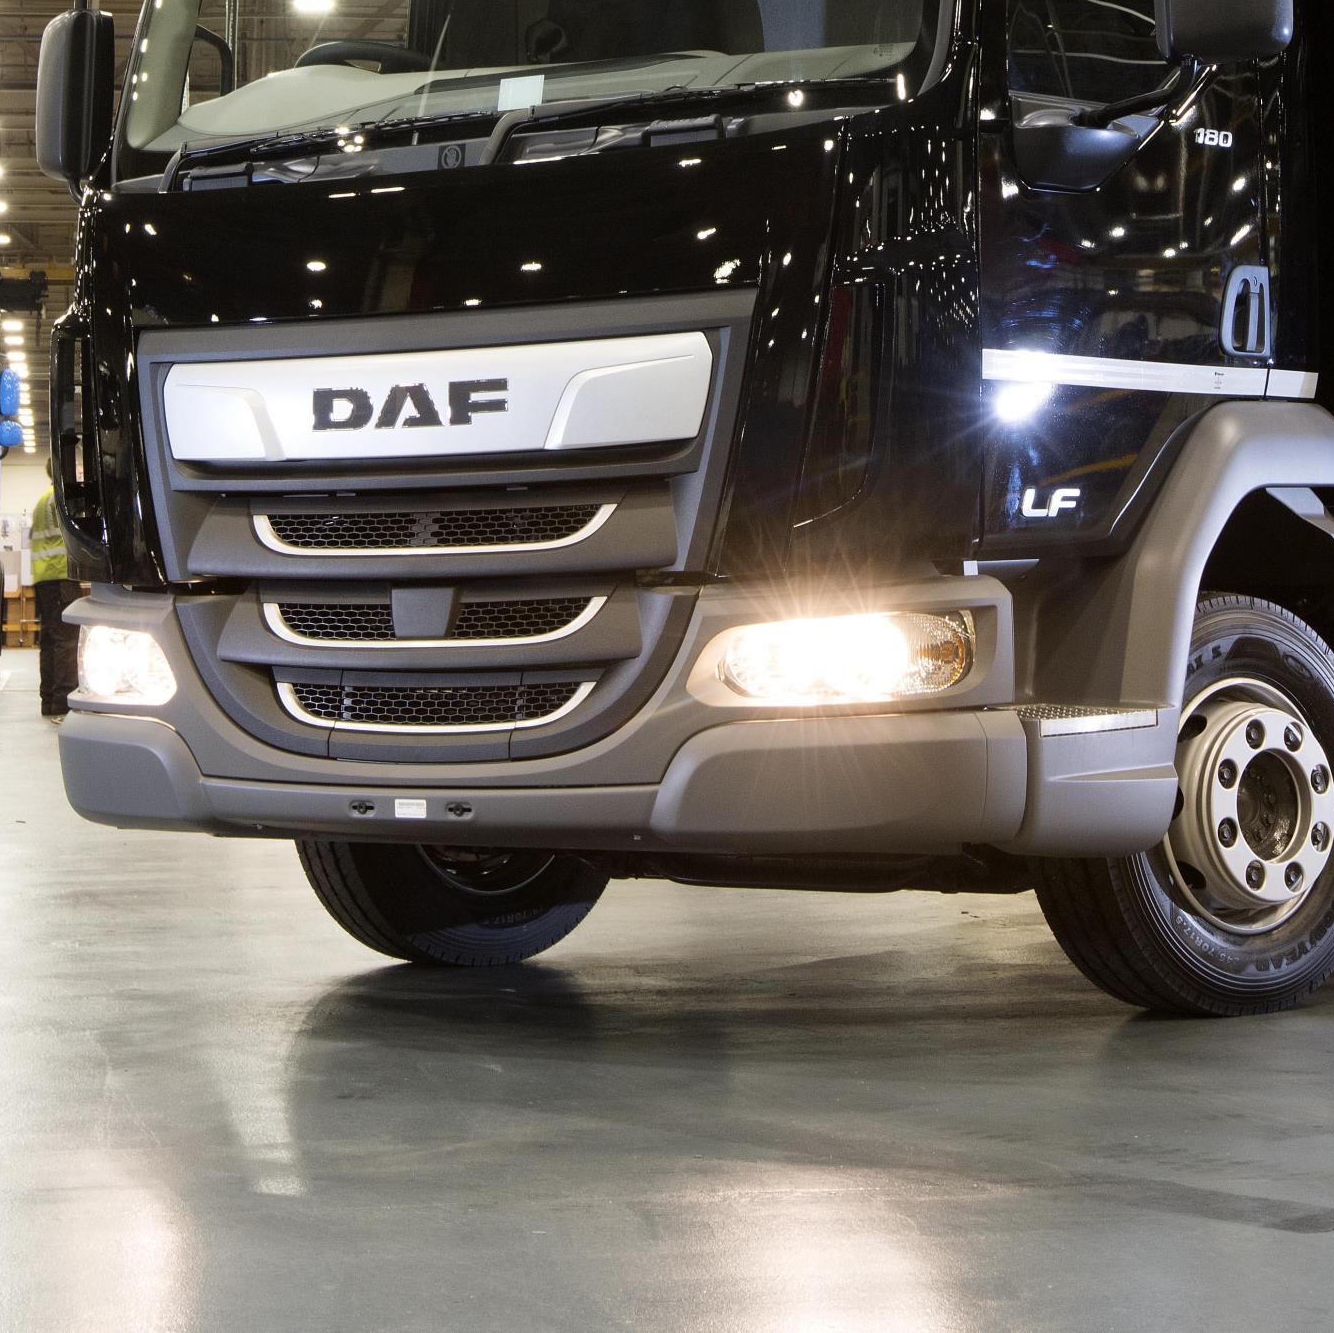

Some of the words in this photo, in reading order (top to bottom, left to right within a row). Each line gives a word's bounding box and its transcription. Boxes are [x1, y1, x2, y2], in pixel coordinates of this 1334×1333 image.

[1193, 127, 1233, 147] 180
[313, 378, 509, 431] DAF
[1022, 488, 1081, 517] LF
